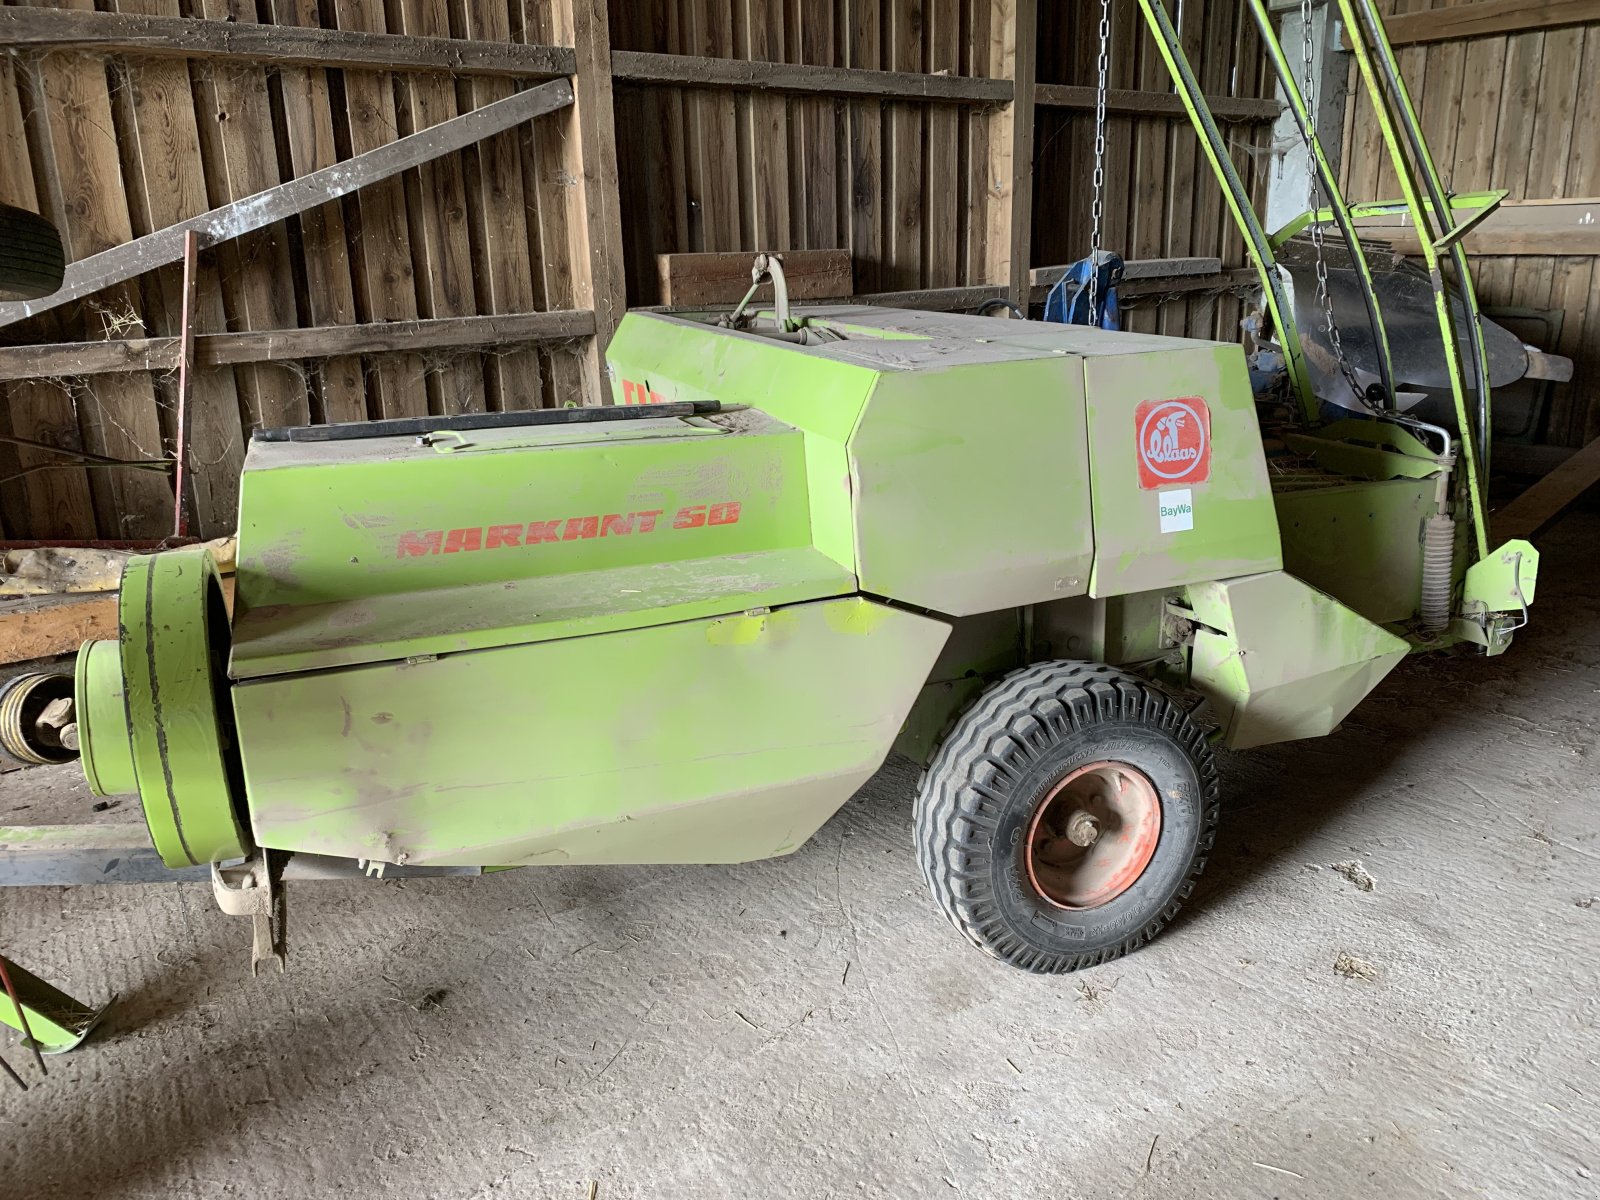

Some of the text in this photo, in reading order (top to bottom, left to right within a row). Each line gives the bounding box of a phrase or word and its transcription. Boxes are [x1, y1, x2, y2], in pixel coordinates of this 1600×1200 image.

[1160, 503, 1192, 517] BayWa
[396, 501, 741, 560] MARKANT 50
